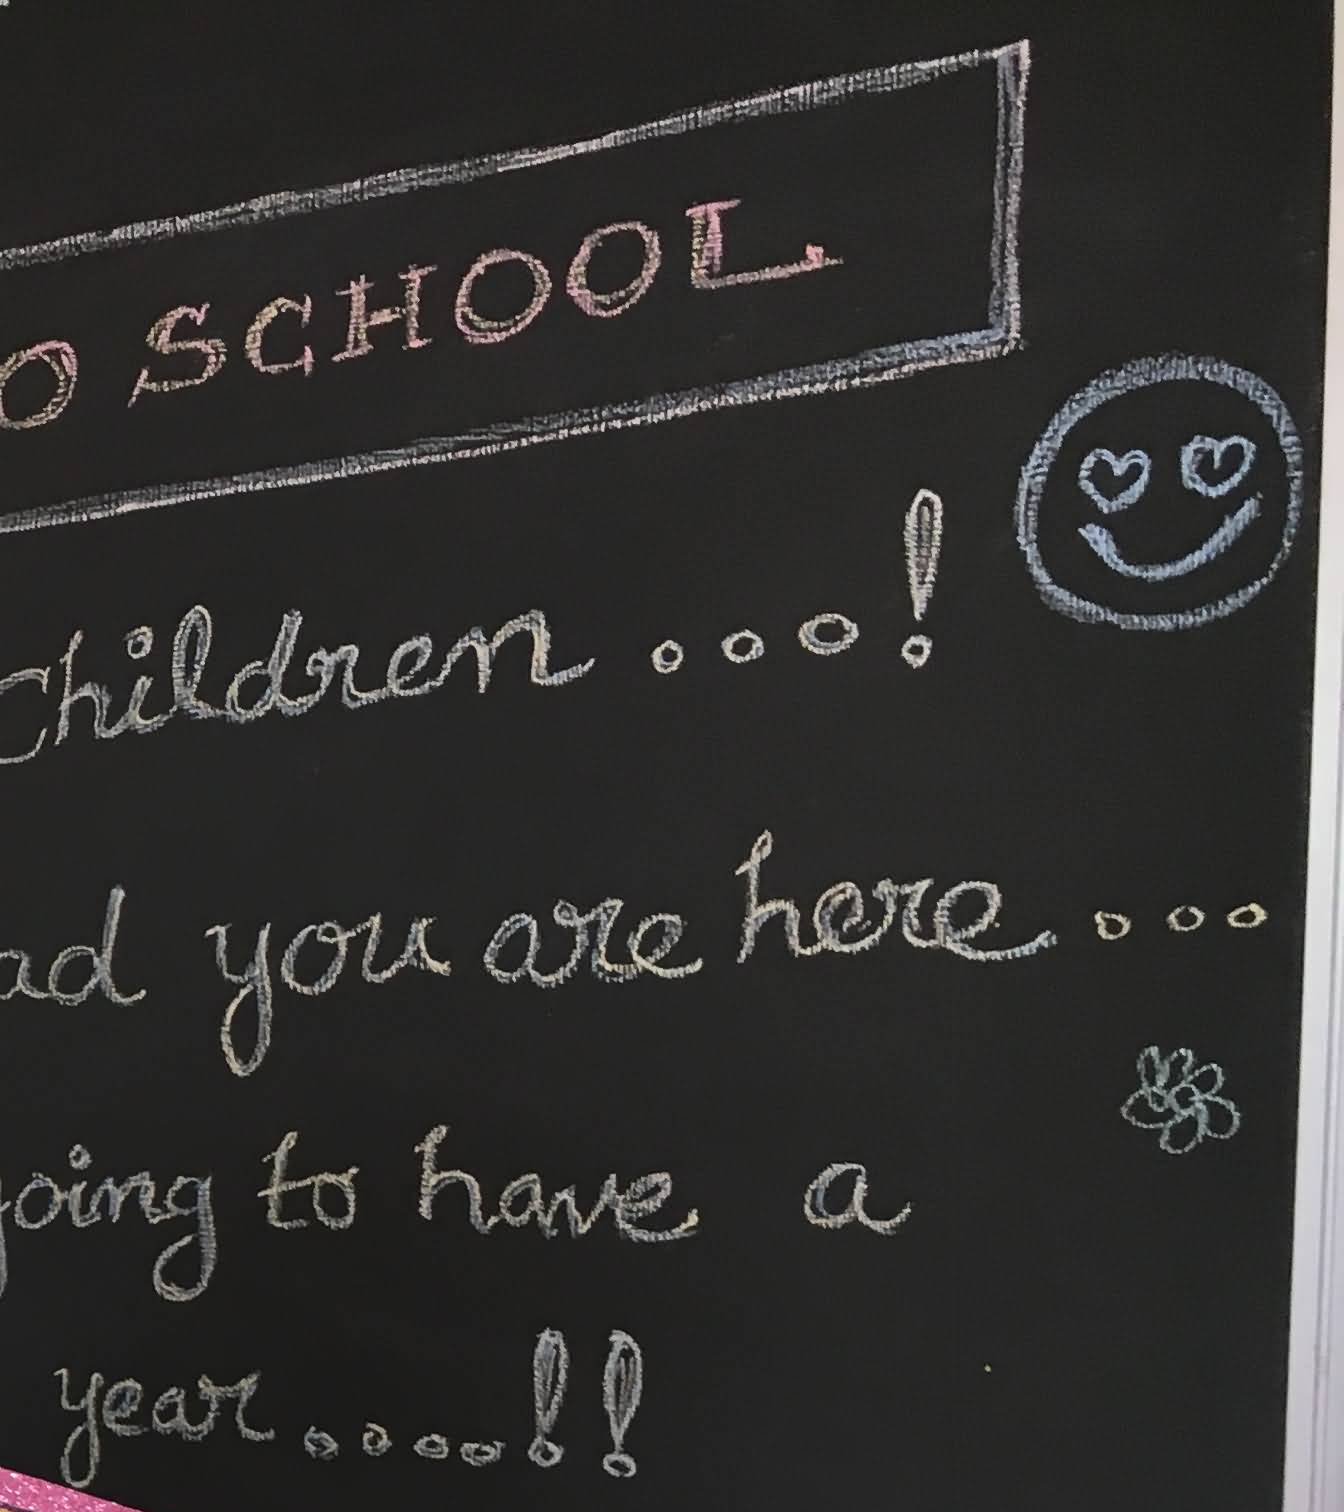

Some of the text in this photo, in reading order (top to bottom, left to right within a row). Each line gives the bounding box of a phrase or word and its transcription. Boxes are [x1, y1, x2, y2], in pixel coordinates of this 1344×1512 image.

[128, 199, 843, 408] SCHOOL
[204, 912, 452, 1077] you
[483, 897, 703, 985] are
[257, 1131, 360, 1230] to
[415, 1125, 700, 1242] have
[804, 1162, 912, 1236] a
